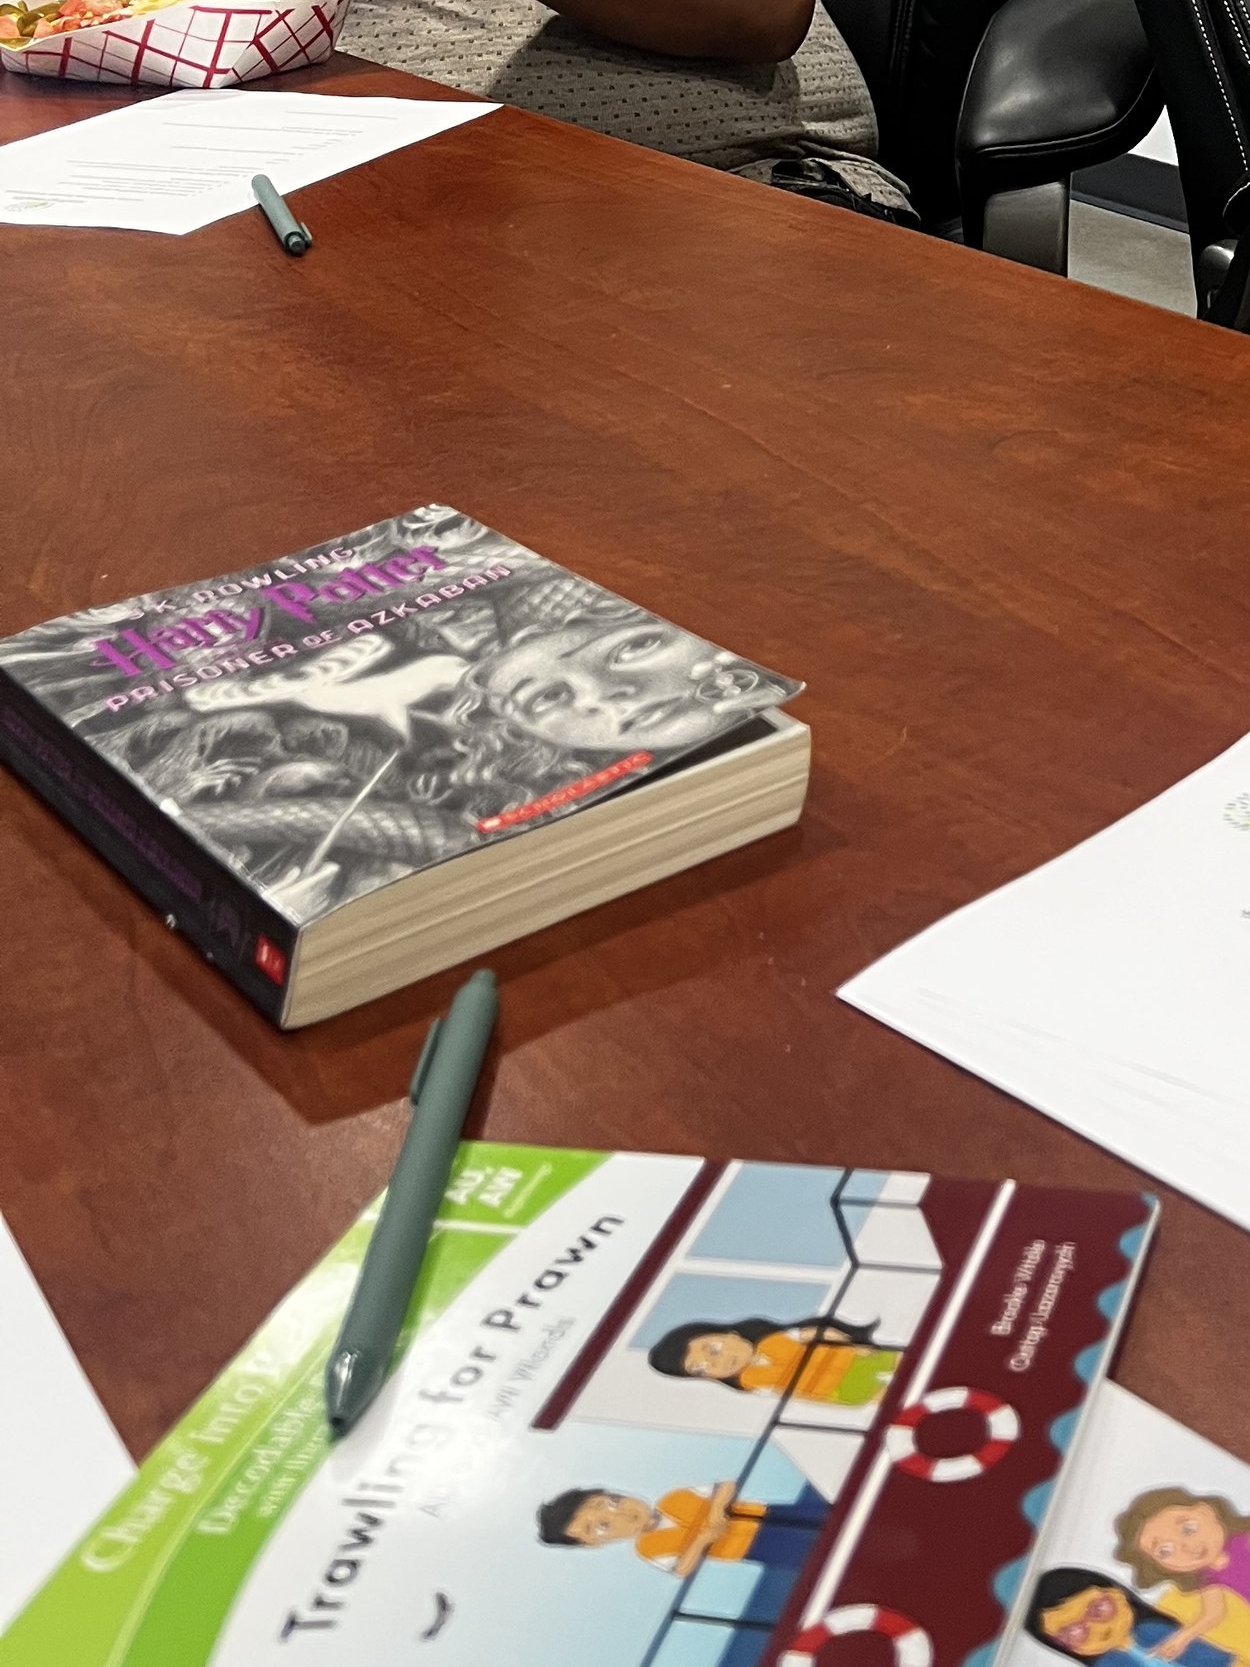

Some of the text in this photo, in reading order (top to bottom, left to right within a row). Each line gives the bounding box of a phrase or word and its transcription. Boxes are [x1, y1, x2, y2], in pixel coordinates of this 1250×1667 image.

[90, 545, 448, 677] Harry Potter
[105, 563, 512, 713] PRISONER OF AZKABAN
[193, 545, 358, 605] ROWLING
[418, 1342, 497, 1405] for
[480, 1213, 625, 1334] Prawn
[79, 1435, 208, 1571] Charge
